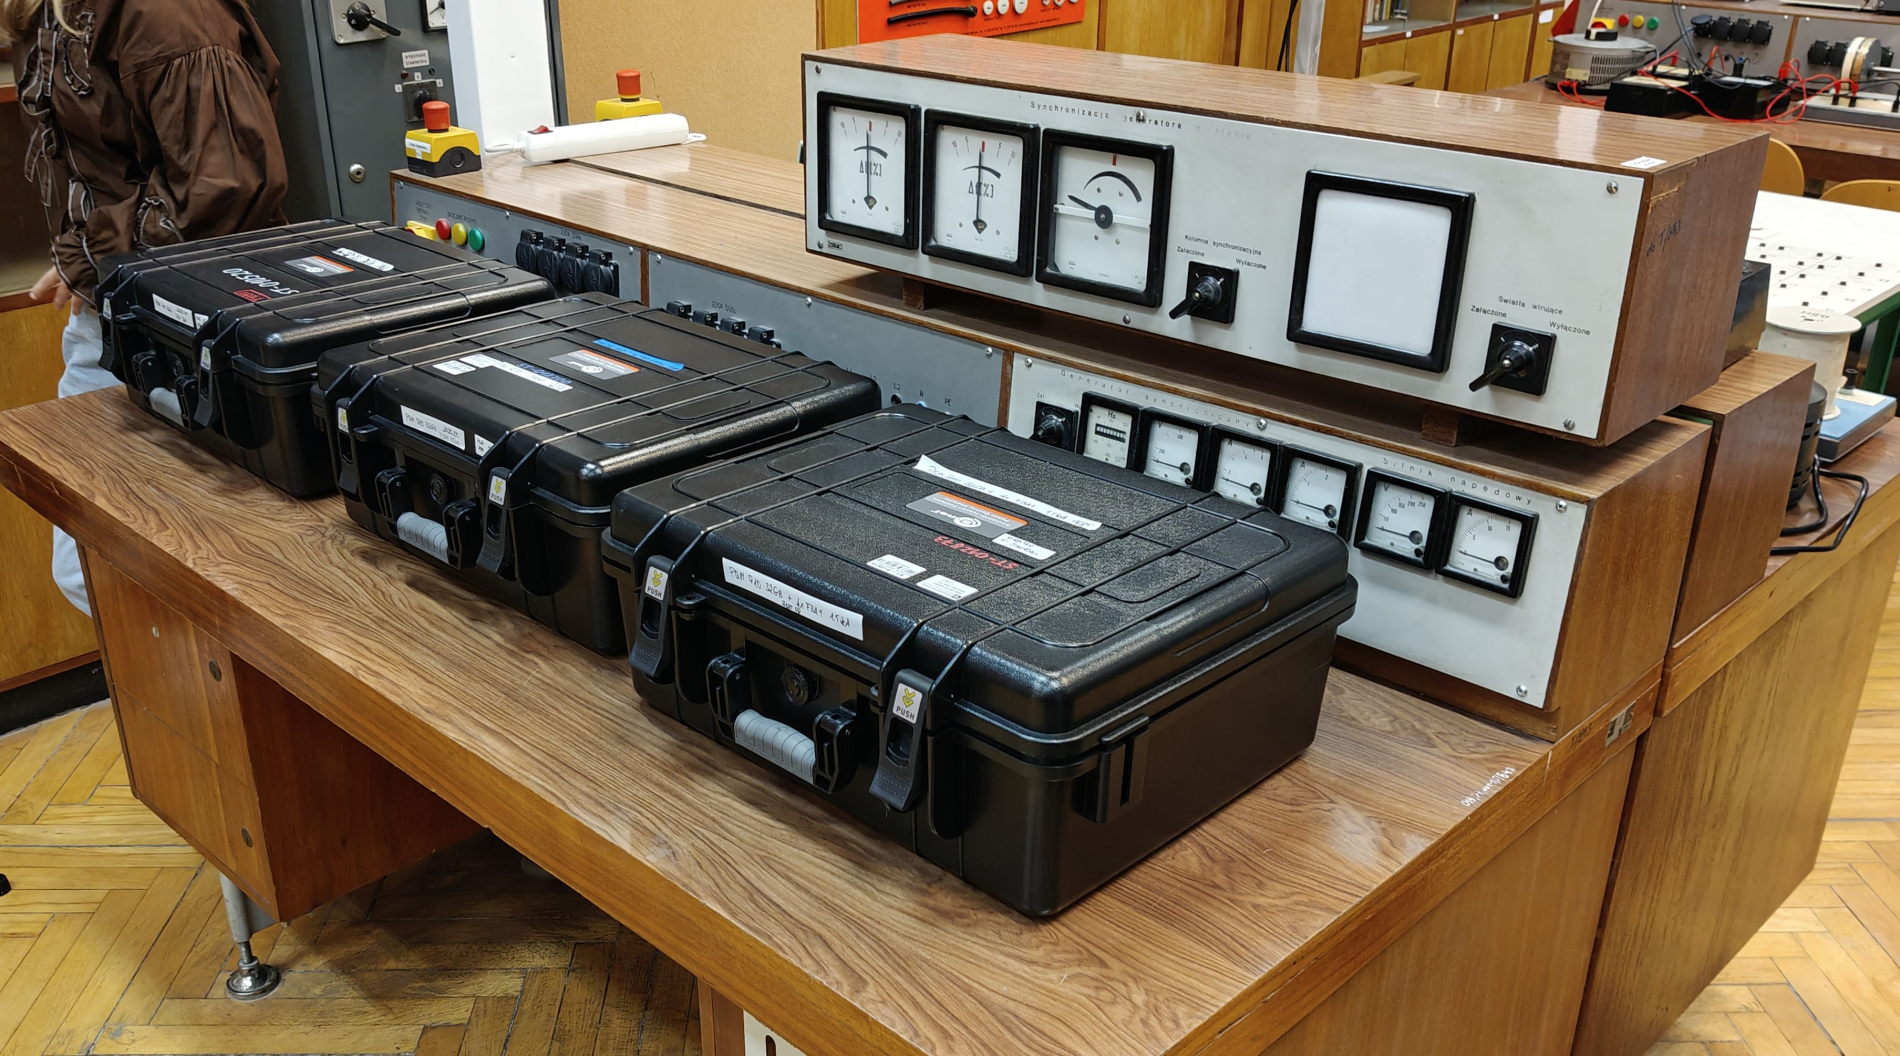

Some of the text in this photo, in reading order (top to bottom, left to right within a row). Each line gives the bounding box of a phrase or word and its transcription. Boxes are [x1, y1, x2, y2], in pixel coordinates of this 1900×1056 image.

[1029, 101, 1110, 120] Synchronizacja
[1184, 234, 1262, 256] Kolumna synchronizacyjna
[1531, 302, 1563, 316] wirujące
[1470, 304, 1591, 336] Załączone Wyłączone
[1060, 370, 1251, 427] Generator synchroniczny
[1107, 410, 1117, 420] Hz
[1300, 461, 1306, 469] A
[1382, 457, 1433, 477] Silnik
[491, 492, 503, 503] PUSH
[1407, 500, 1416, 508] 200
[1417, 500, 1426, 508] 250
[1466, 508, 1473, 516] A
[1505, 524, 1511, 532] 15
[646, 585, 663, 598] PUSH
[765, 582, 784, 599] 32GB
[895, 706, 915, 720] PUSH
